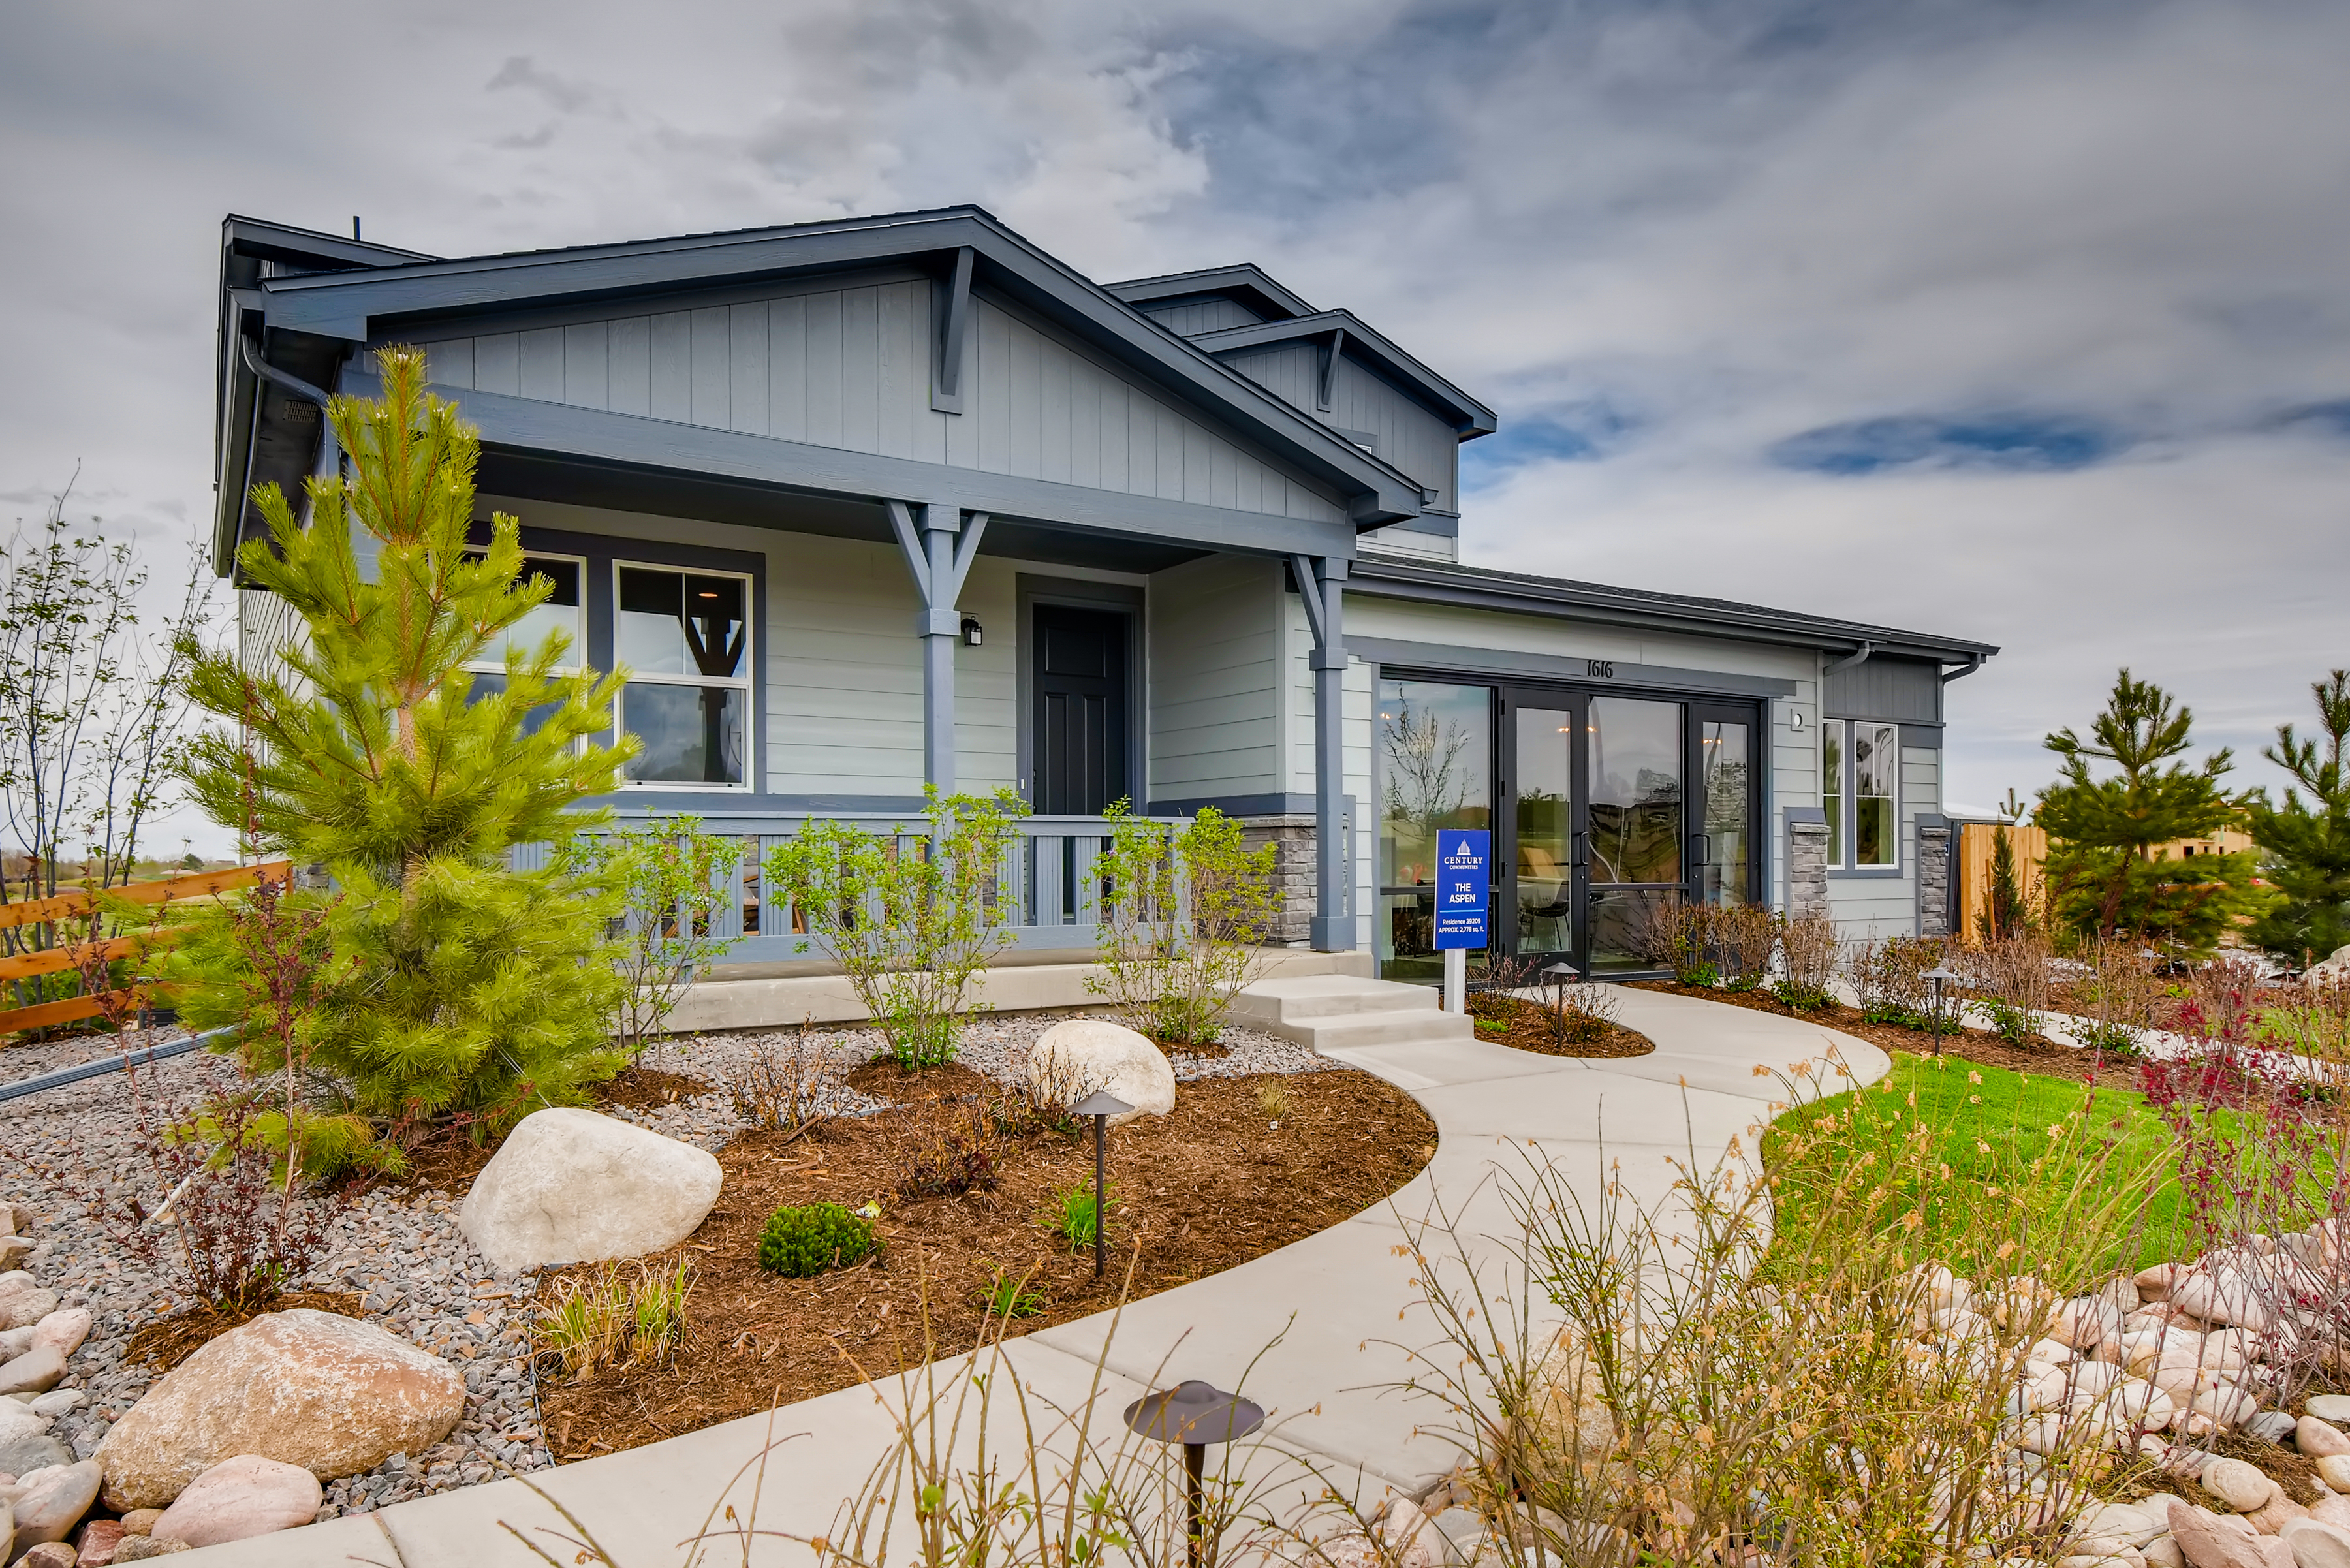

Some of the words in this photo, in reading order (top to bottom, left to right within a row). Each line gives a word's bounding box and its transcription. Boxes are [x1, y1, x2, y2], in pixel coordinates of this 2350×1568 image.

[1588, 659, 1613, 678] 1616
[1455, 883, 1471, 892] THE
[1449, 894, 1475, 903] ASPEN
